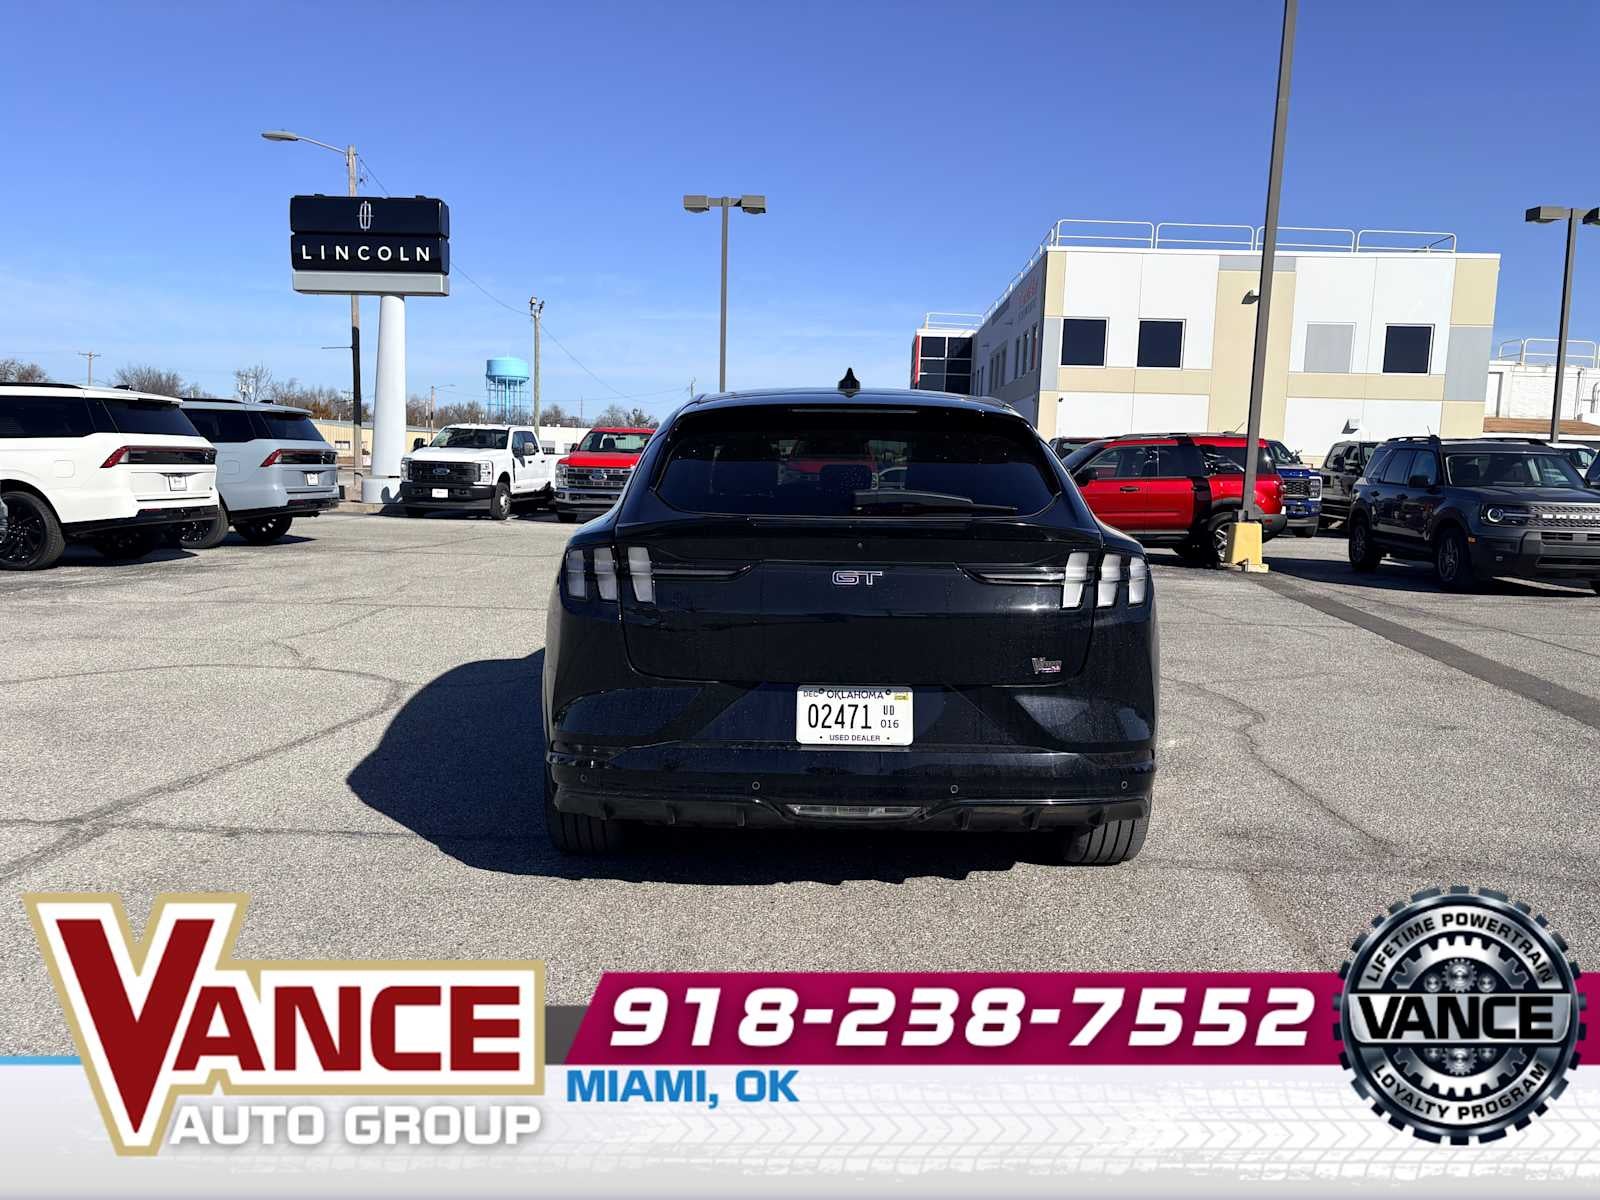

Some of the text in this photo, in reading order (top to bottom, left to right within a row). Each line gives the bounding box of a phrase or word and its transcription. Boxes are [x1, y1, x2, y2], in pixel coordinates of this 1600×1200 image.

[301, 244, 430, 262] LINCOLN
[832, 570, 882, 585] GT
[803, 690, 819, 698] DEC
[826, 690, 884, 700] OKLAHOMA
[808, 703, 872, 729] 02471
[880, 719, 900, 729] 016
[829, 734, 881, 742] USED DEALER
